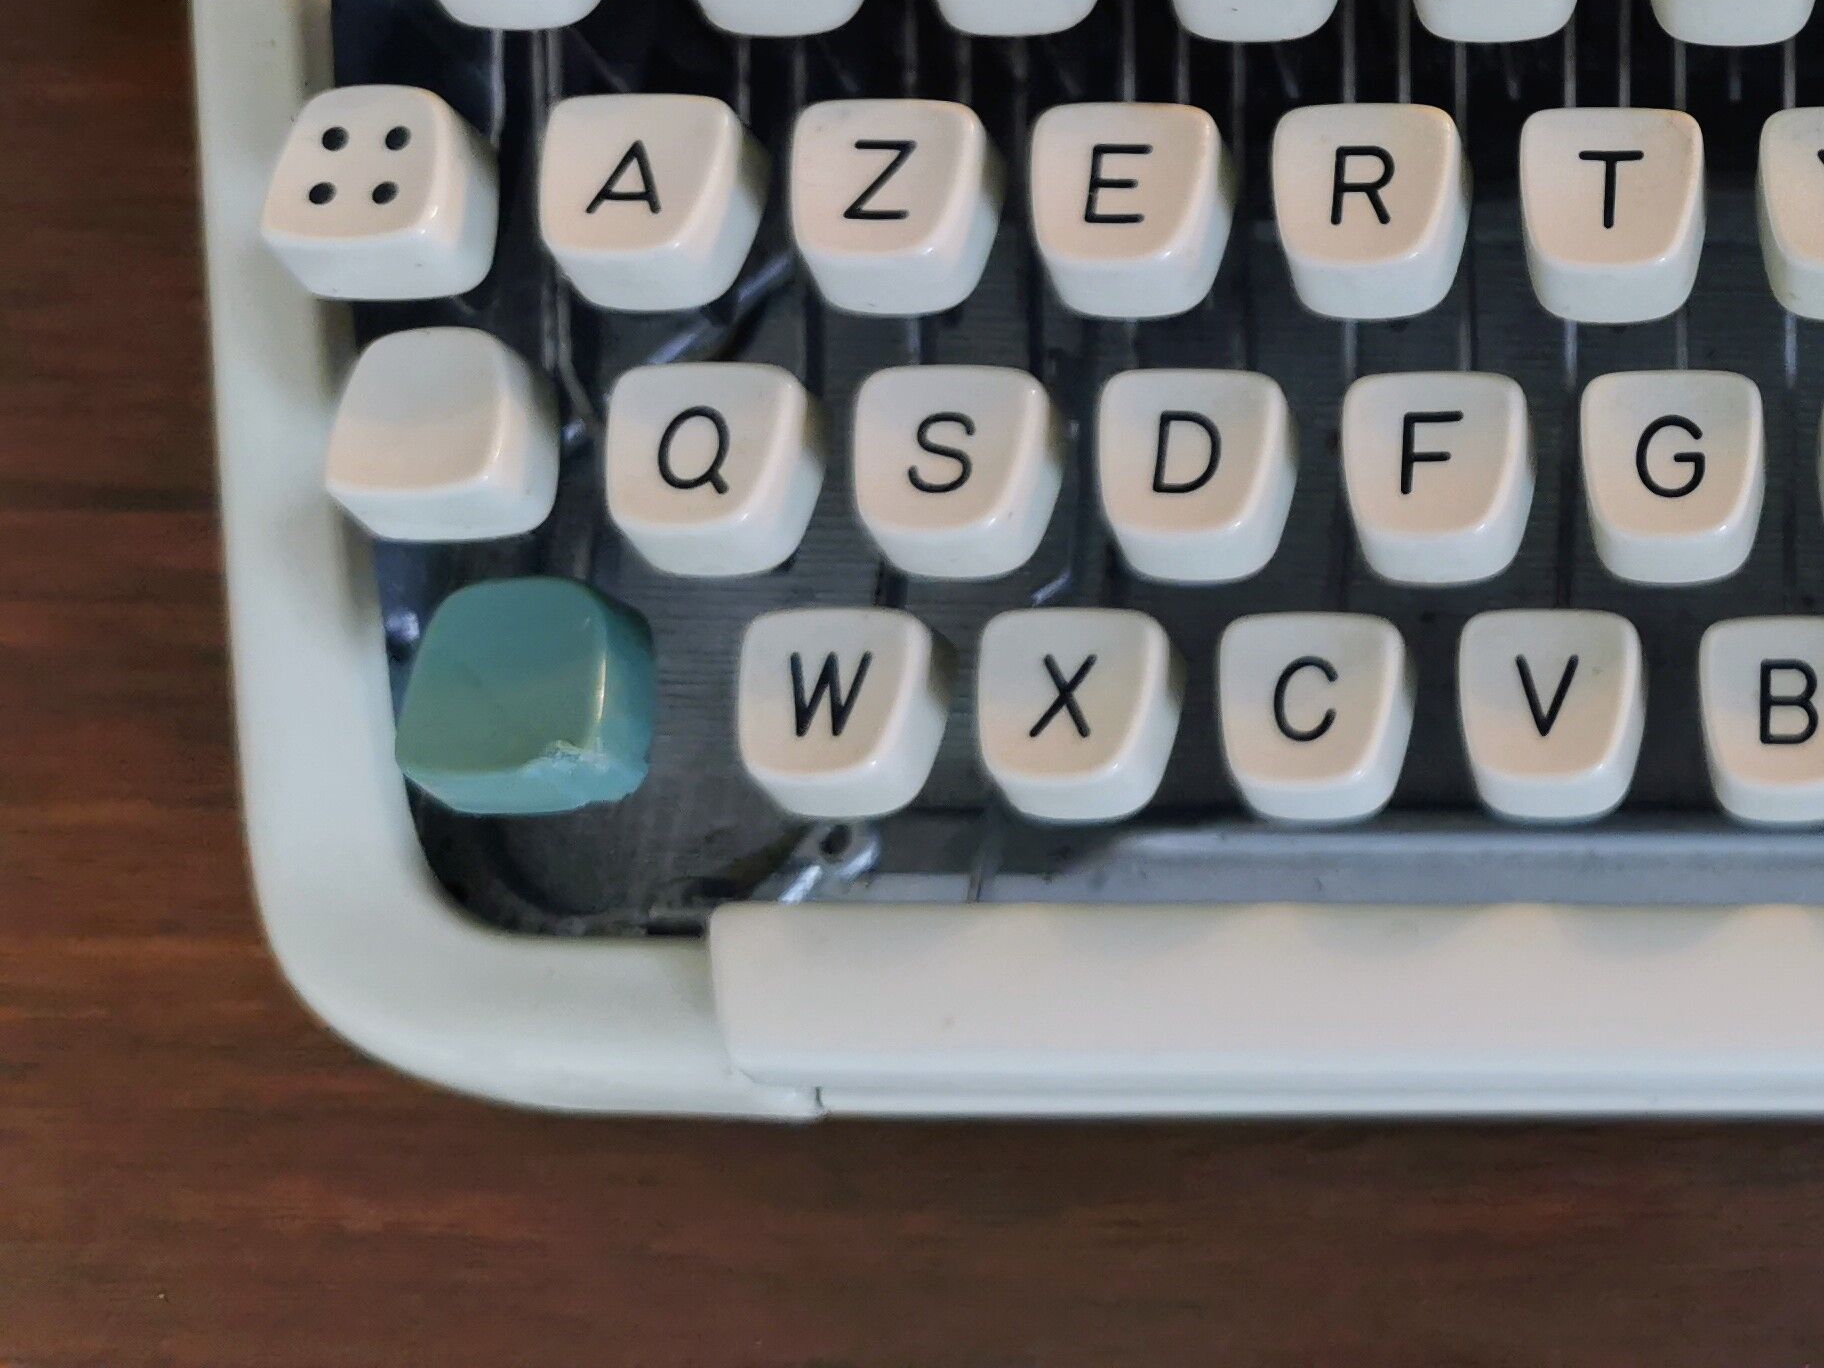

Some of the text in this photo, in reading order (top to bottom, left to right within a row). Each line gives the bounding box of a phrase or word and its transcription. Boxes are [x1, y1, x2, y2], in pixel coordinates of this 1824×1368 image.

[586, 141, 660, 214] A
[843, 140, 915, 220] Z
[1084, 144, 1151, 224] E
[1331, 146, 1394, 225] R
[1579, 151, 1644, 229] T
[657, 406, 729, 494] Q
[907, 412, 975, 494] S
[1152, 411, 1220, 494] D
[1400, 411, 1463, 495] F
[1636, 415, 1705, 498] G
[790, 652, 871, 737] W
[1029, 655, 1096, 738] X
[1273, 657, 1337, 742] C
[1515, 656, 1578, 737] V
[1759, 660, 1818, 745] B
